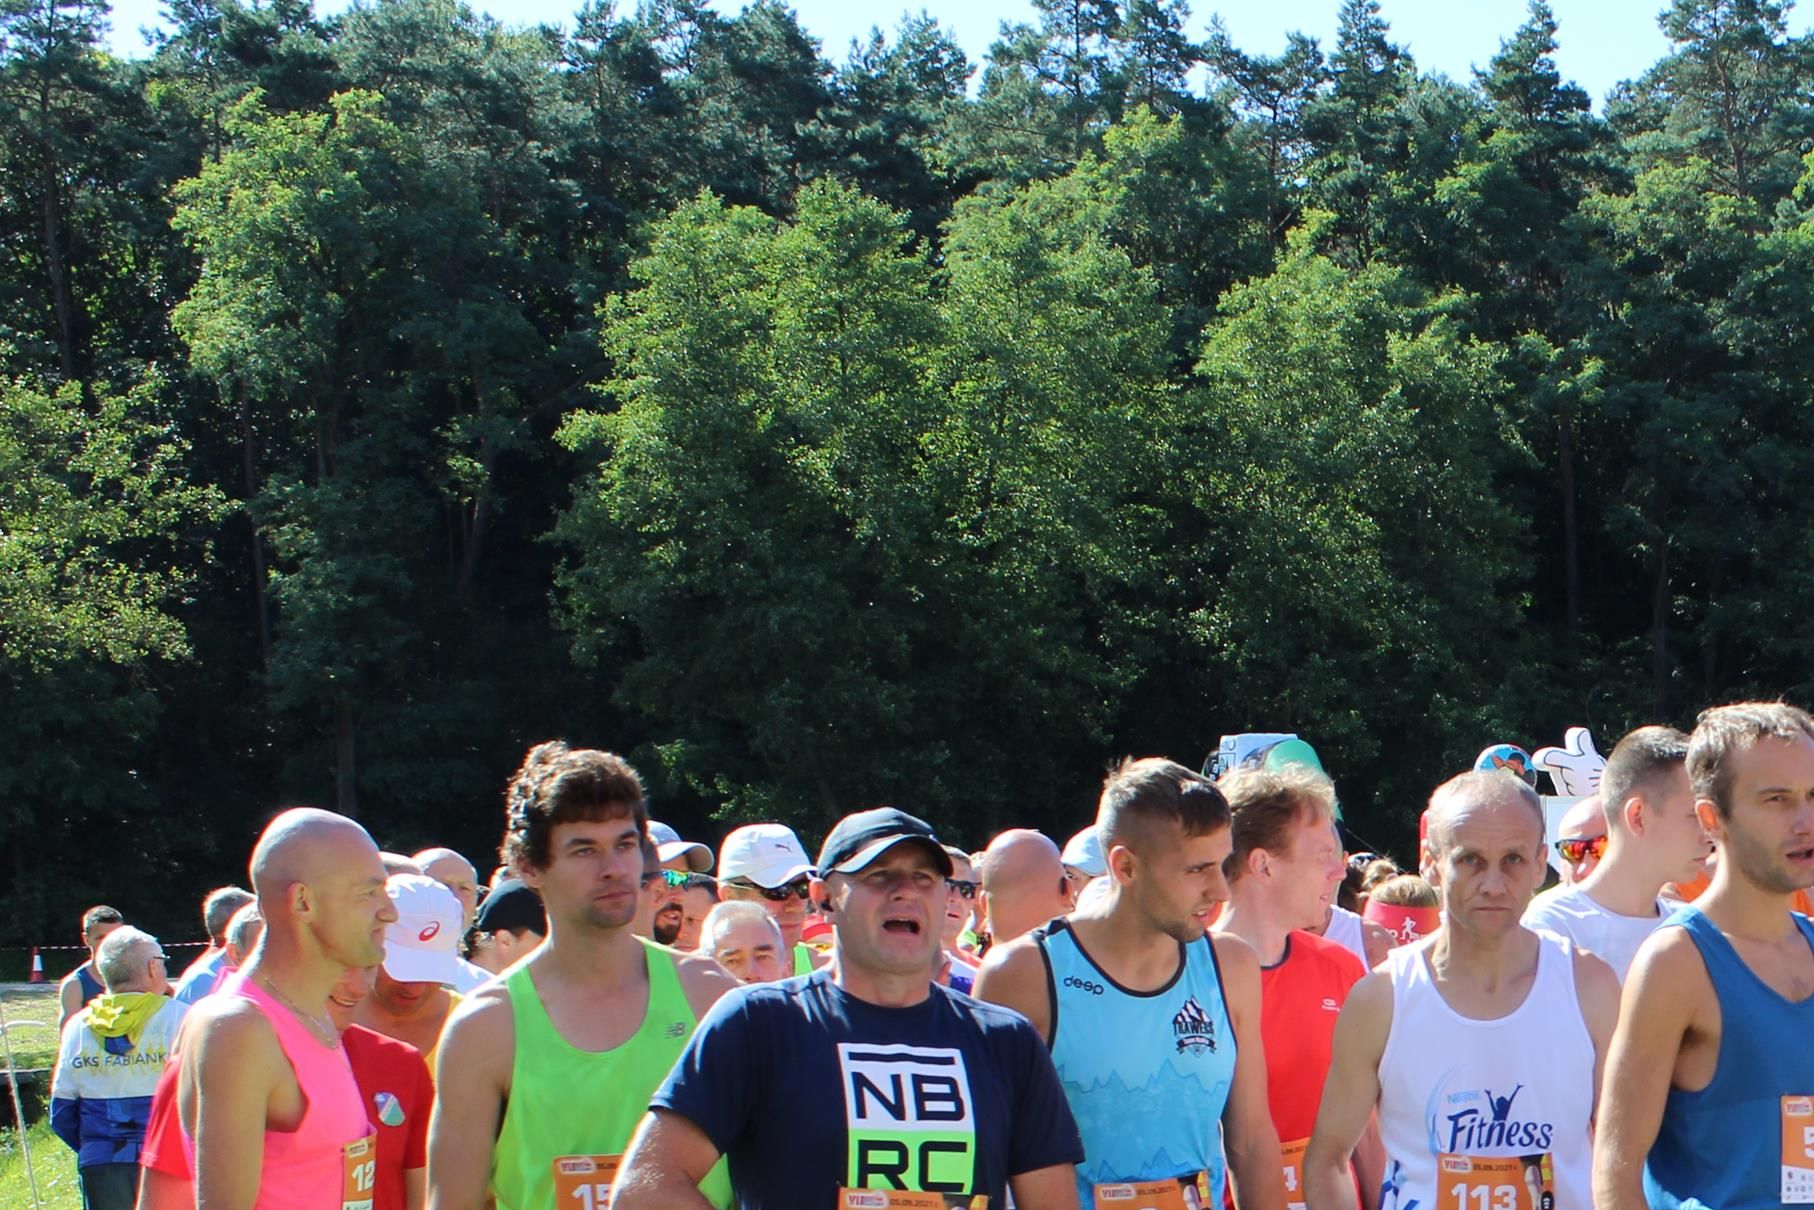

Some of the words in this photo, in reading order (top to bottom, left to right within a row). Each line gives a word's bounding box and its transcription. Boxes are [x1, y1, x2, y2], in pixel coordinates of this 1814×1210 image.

[1063, 976, 1104, 995] deep
[72, 1056, 99, 1069] GKS
[105, 1052, 169, 1066] FABIANK
[850, 1071, 966, 1121] NB
[1447, 1108, 1553, 1153] Fitness
[857, 1139, 968, 1192] RC
